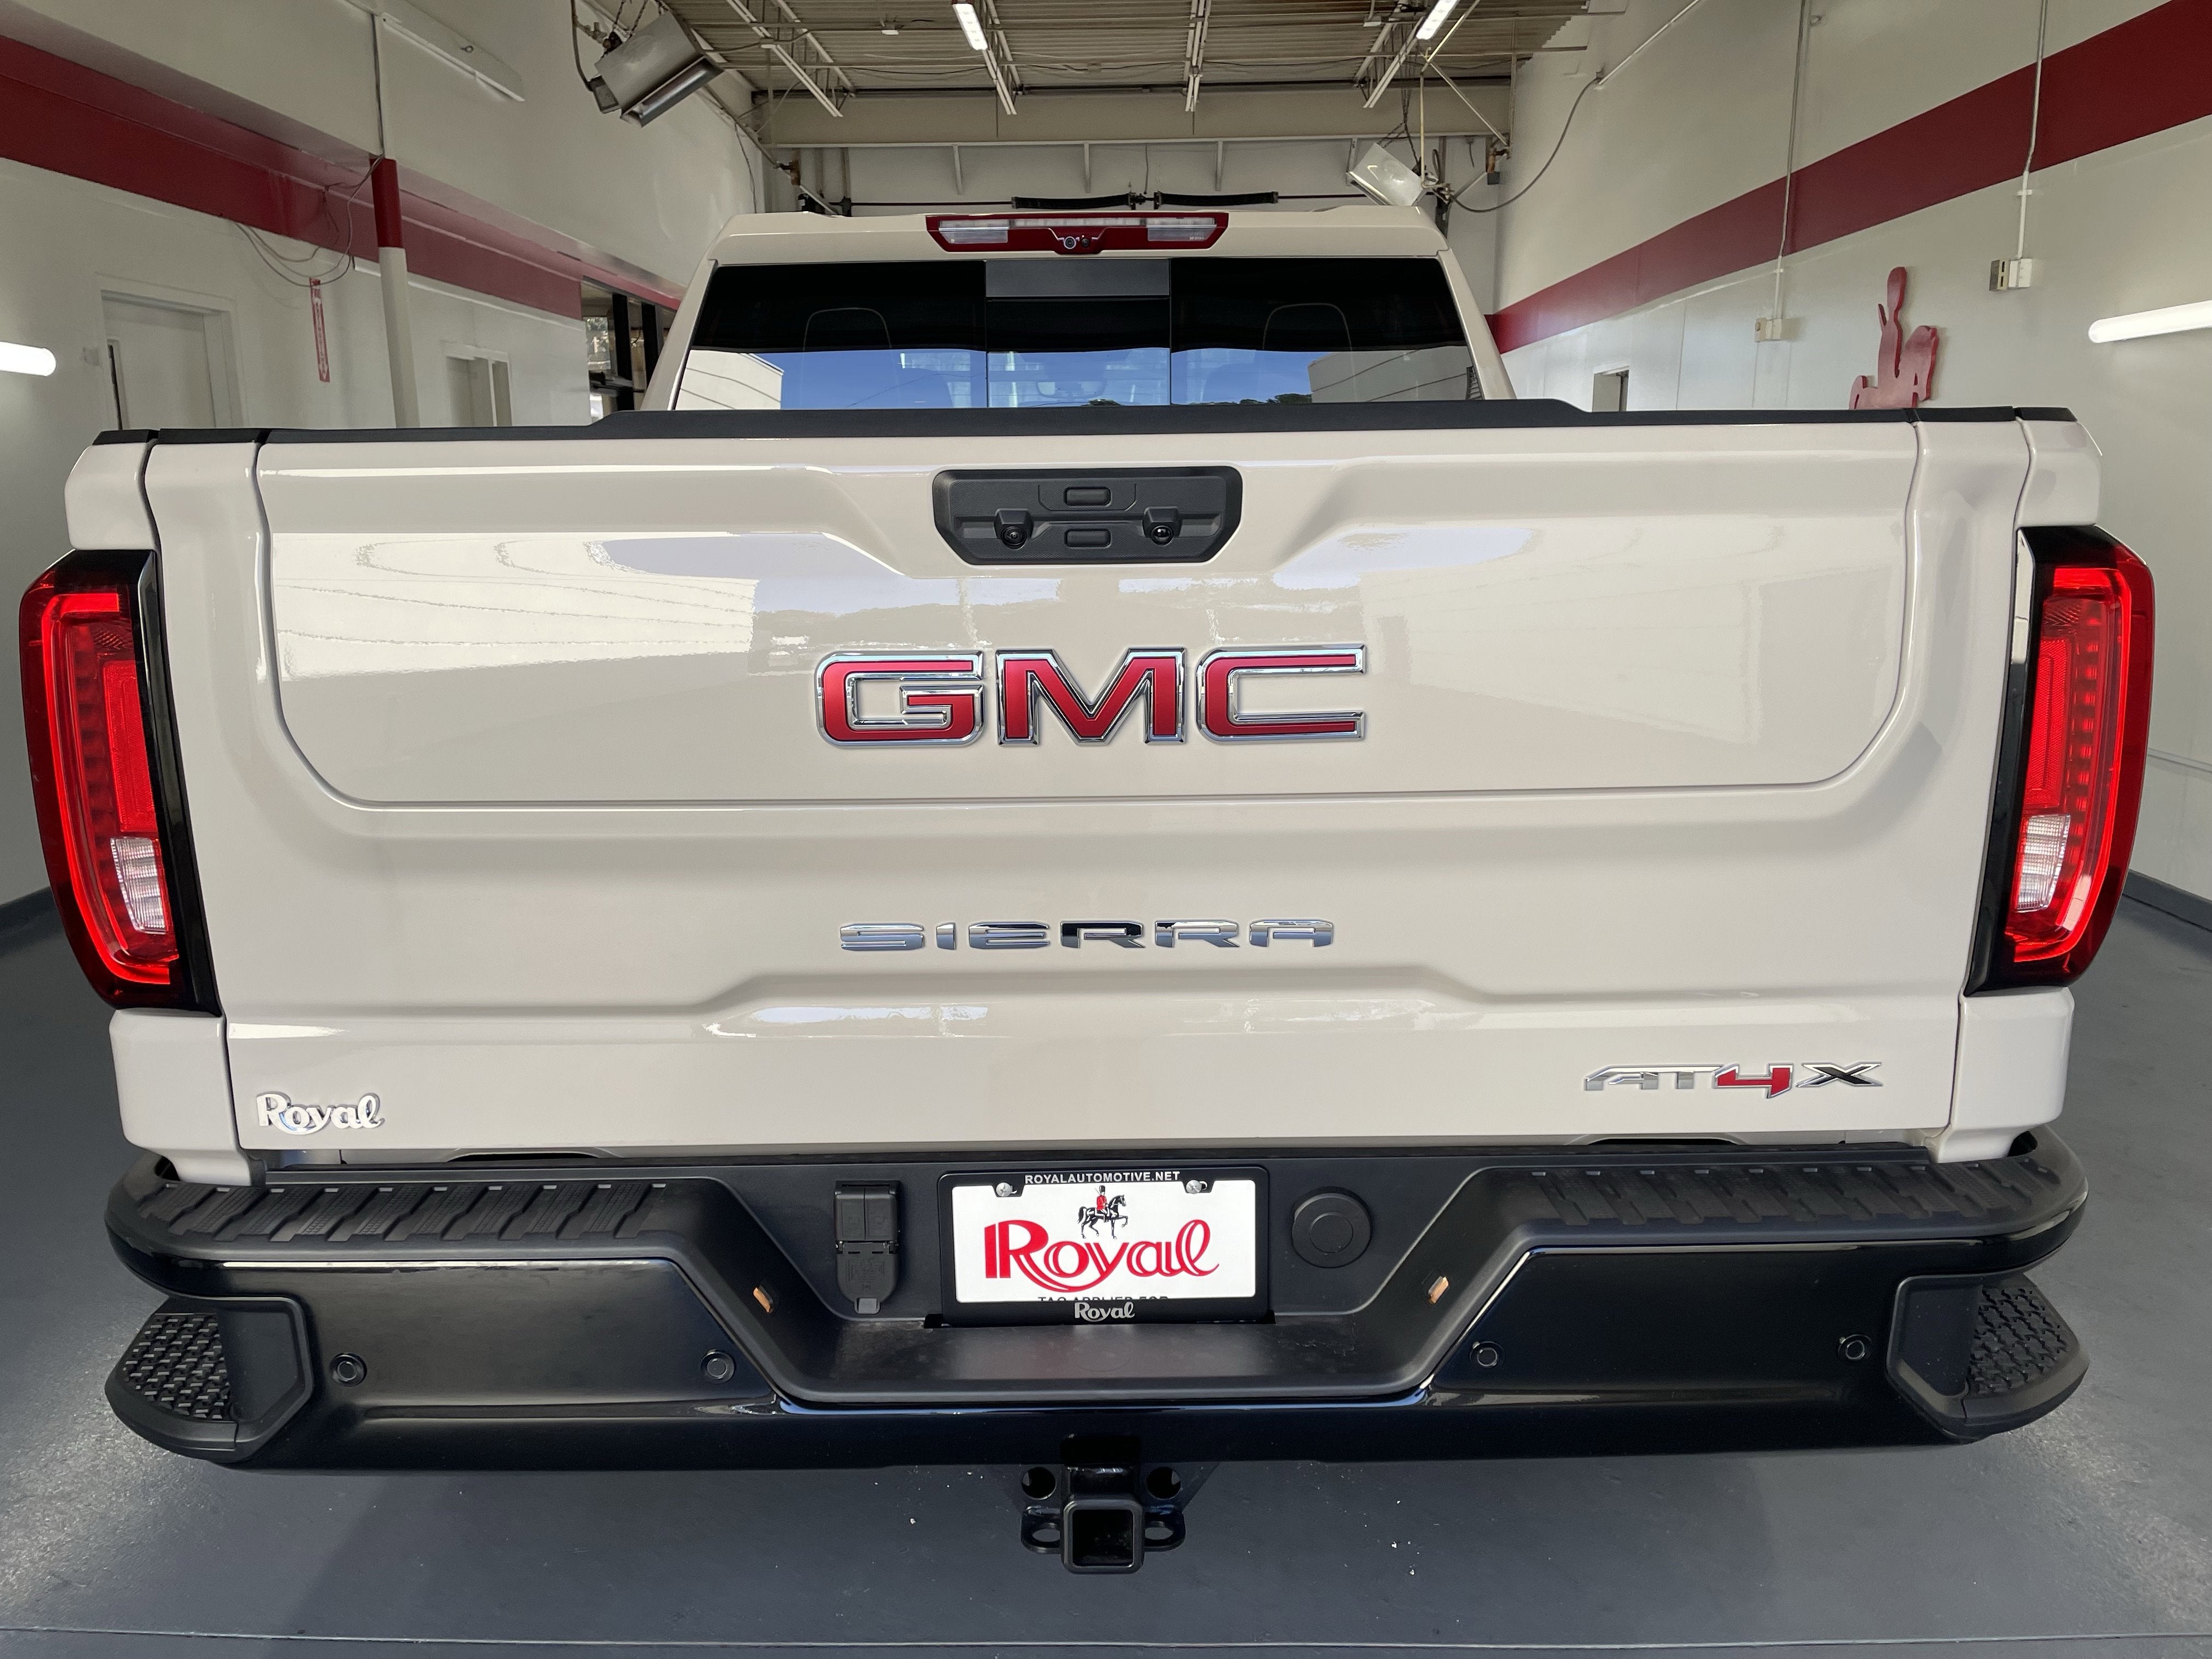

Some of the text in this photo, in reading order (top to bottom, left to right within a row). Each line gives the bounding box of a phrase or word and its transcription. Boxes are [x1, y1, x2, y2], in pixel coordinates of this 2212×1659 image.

[815, 645, 1367, 746] GMC
[840, 919, 1334, 951] SIERRA
[1585, 1062, 1883, 1098] AT4X
[256, 1091, 385, 1135] Royal
[1025, 1171, 1181, 1184] ROYALAUTOMOTIVE.NET
[984, 1219, 1220, 1293] Royal
[1074, 1301, 1135, 1322] Royal
